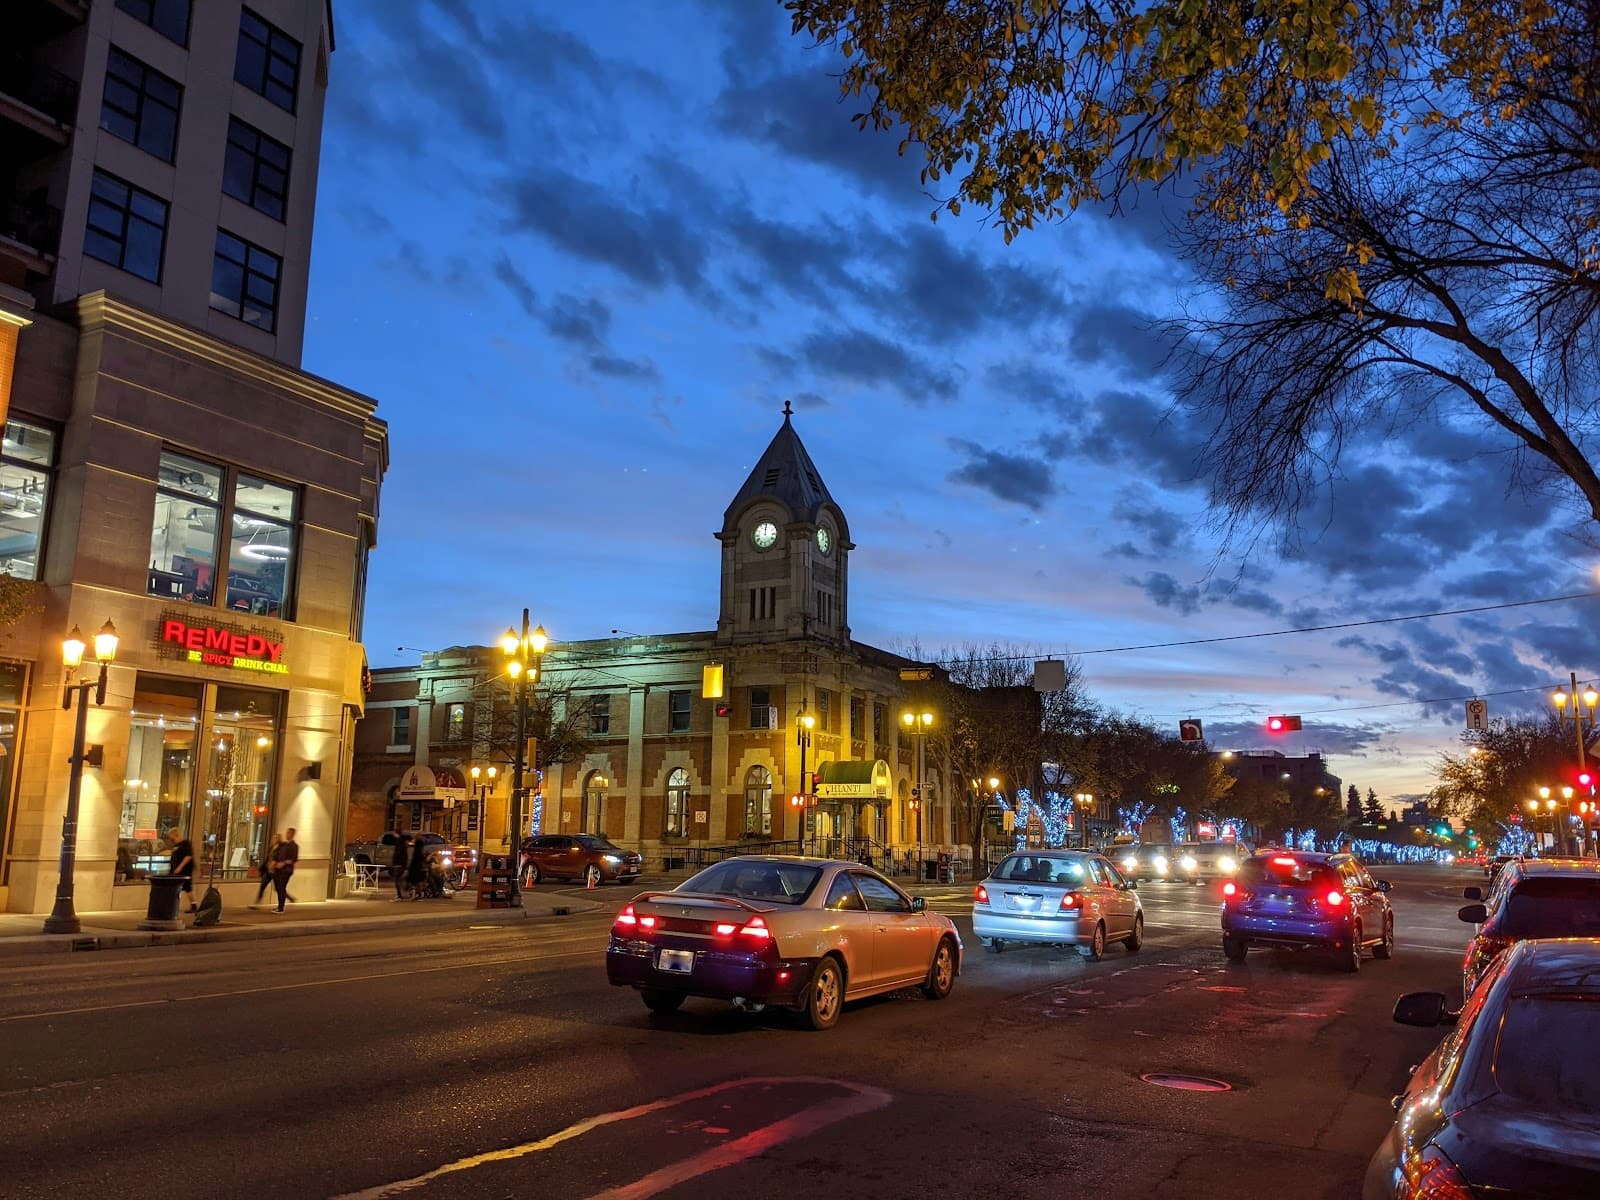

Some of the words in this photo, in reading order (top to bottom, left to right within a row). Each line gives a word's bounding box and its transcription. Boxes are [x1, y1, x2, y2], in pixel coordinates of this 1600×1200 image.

[165, 621, 283, 661] REMEDY
[188, 651, 202, 661] BE
[233, 658, 264, 670] DRINK
